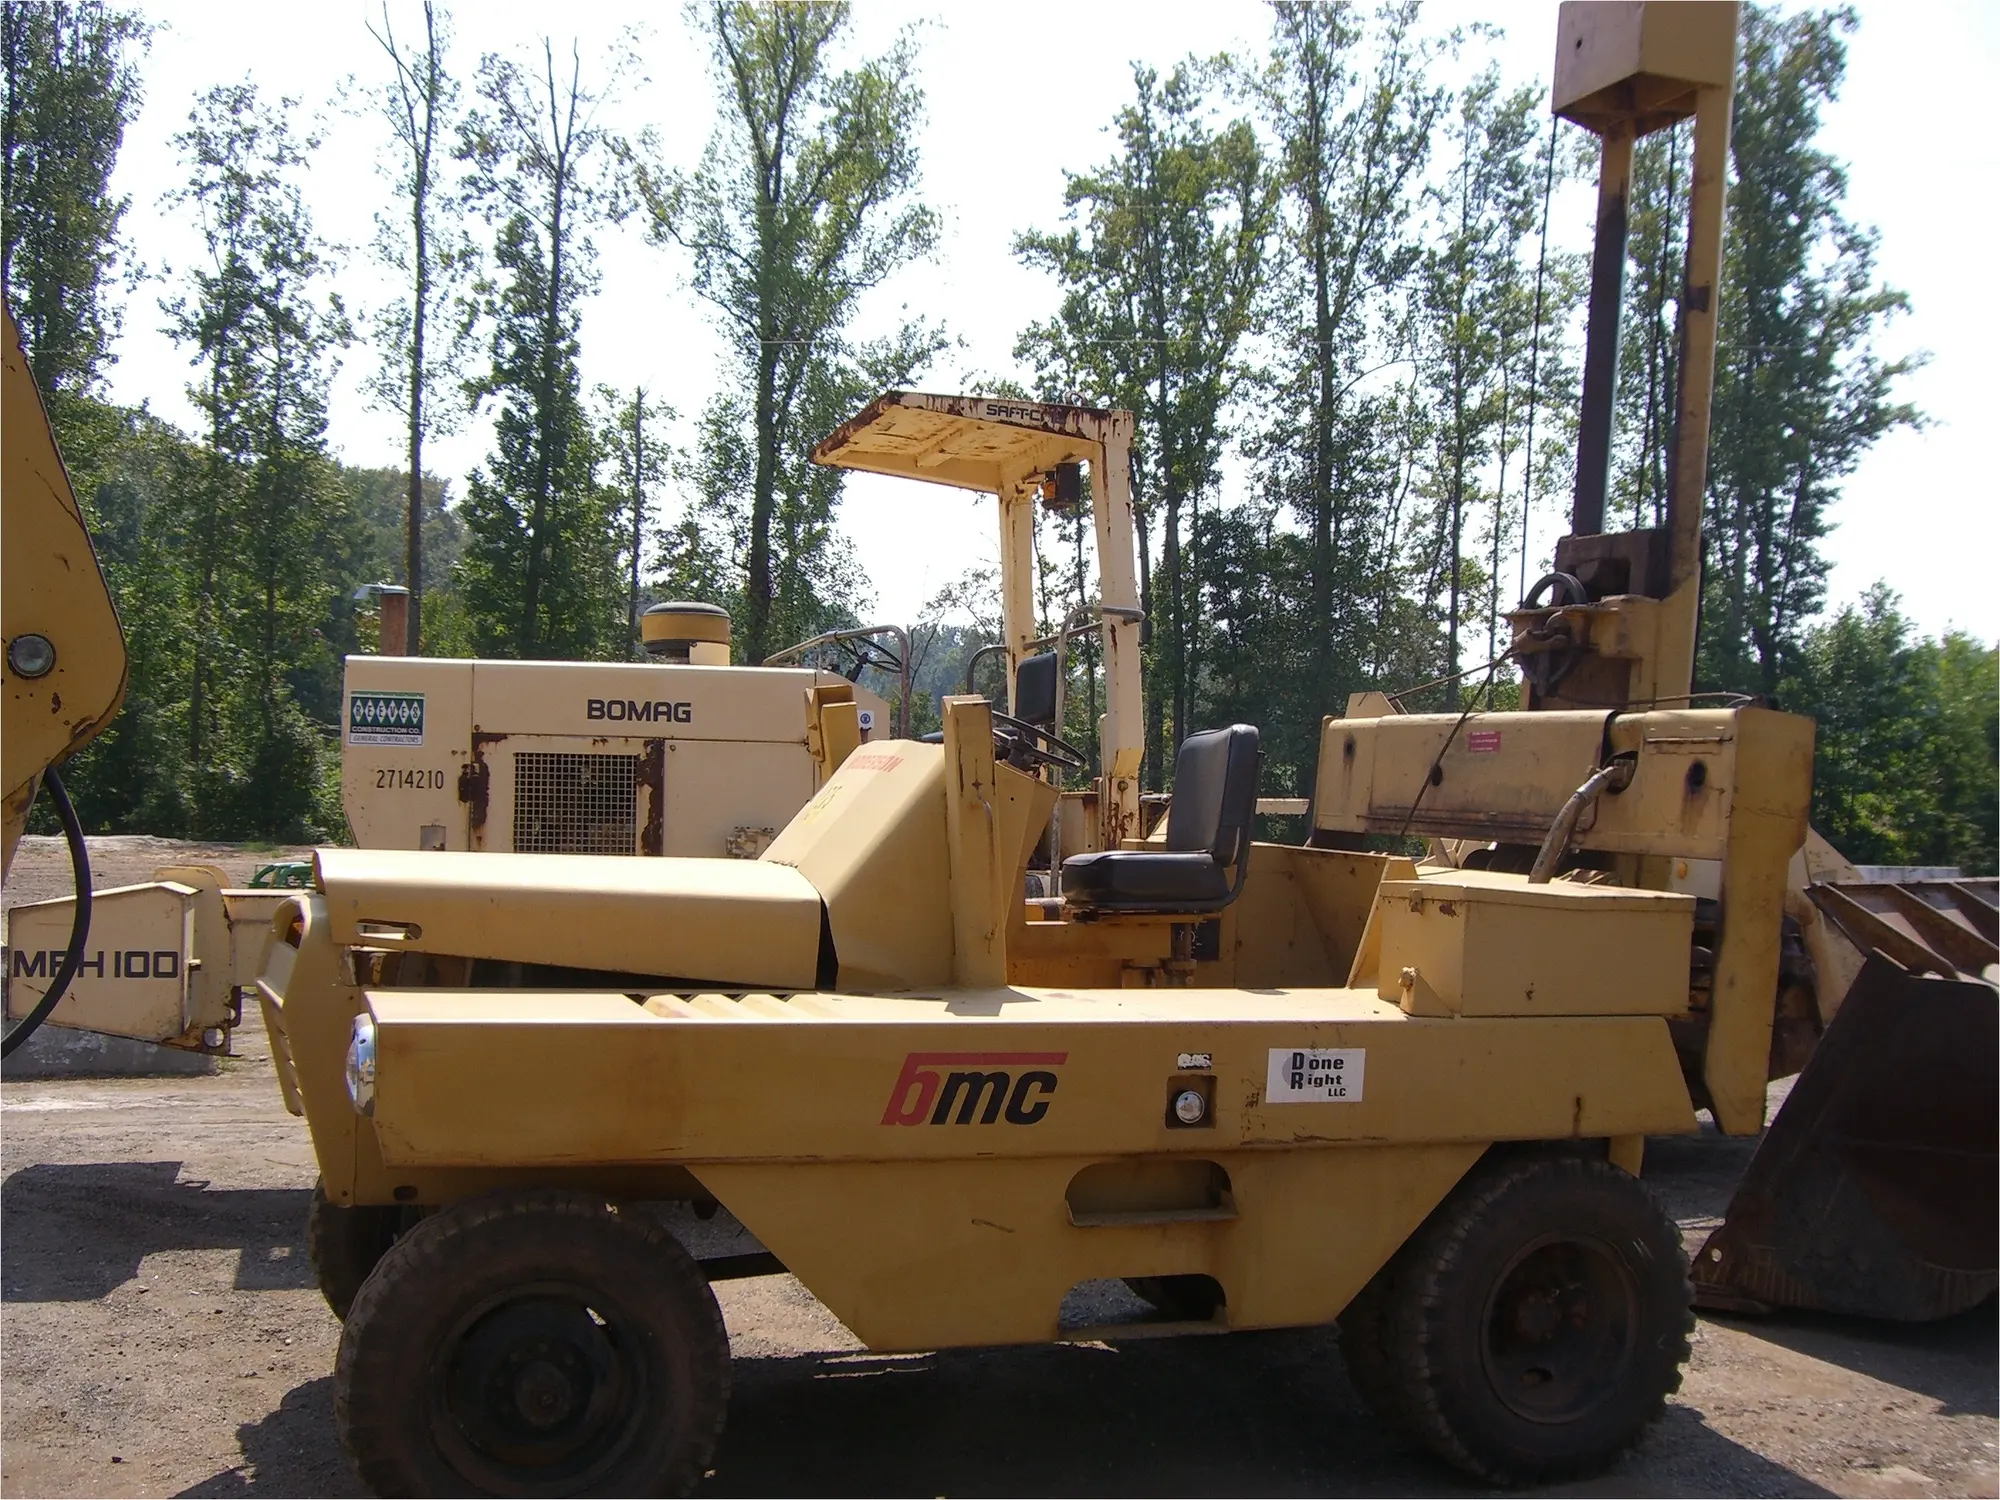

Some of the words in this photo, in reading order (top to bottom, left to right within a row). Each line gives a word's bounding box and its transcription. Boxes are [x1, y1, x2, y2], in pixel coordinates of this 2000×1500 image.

[355, 704, 419, 719] REEVES
[587, 699, 691, 723] BOMAG
[352, 726, 407, 734] CONSTRUCTION
[408, 727, 420, 735] CO.
[379, 735, 419, 743] CONTRACTORS
[376, 769, 444, 789] 2714210
[114, 951, 178, 978] 100
[1292, 1052, 1344, 1070] Done
[880, 1052, 1068, 1126] bmc
[1291, 1072, 1342, 1089] Right
[1328, 1088, 1346, 1097] LLC
